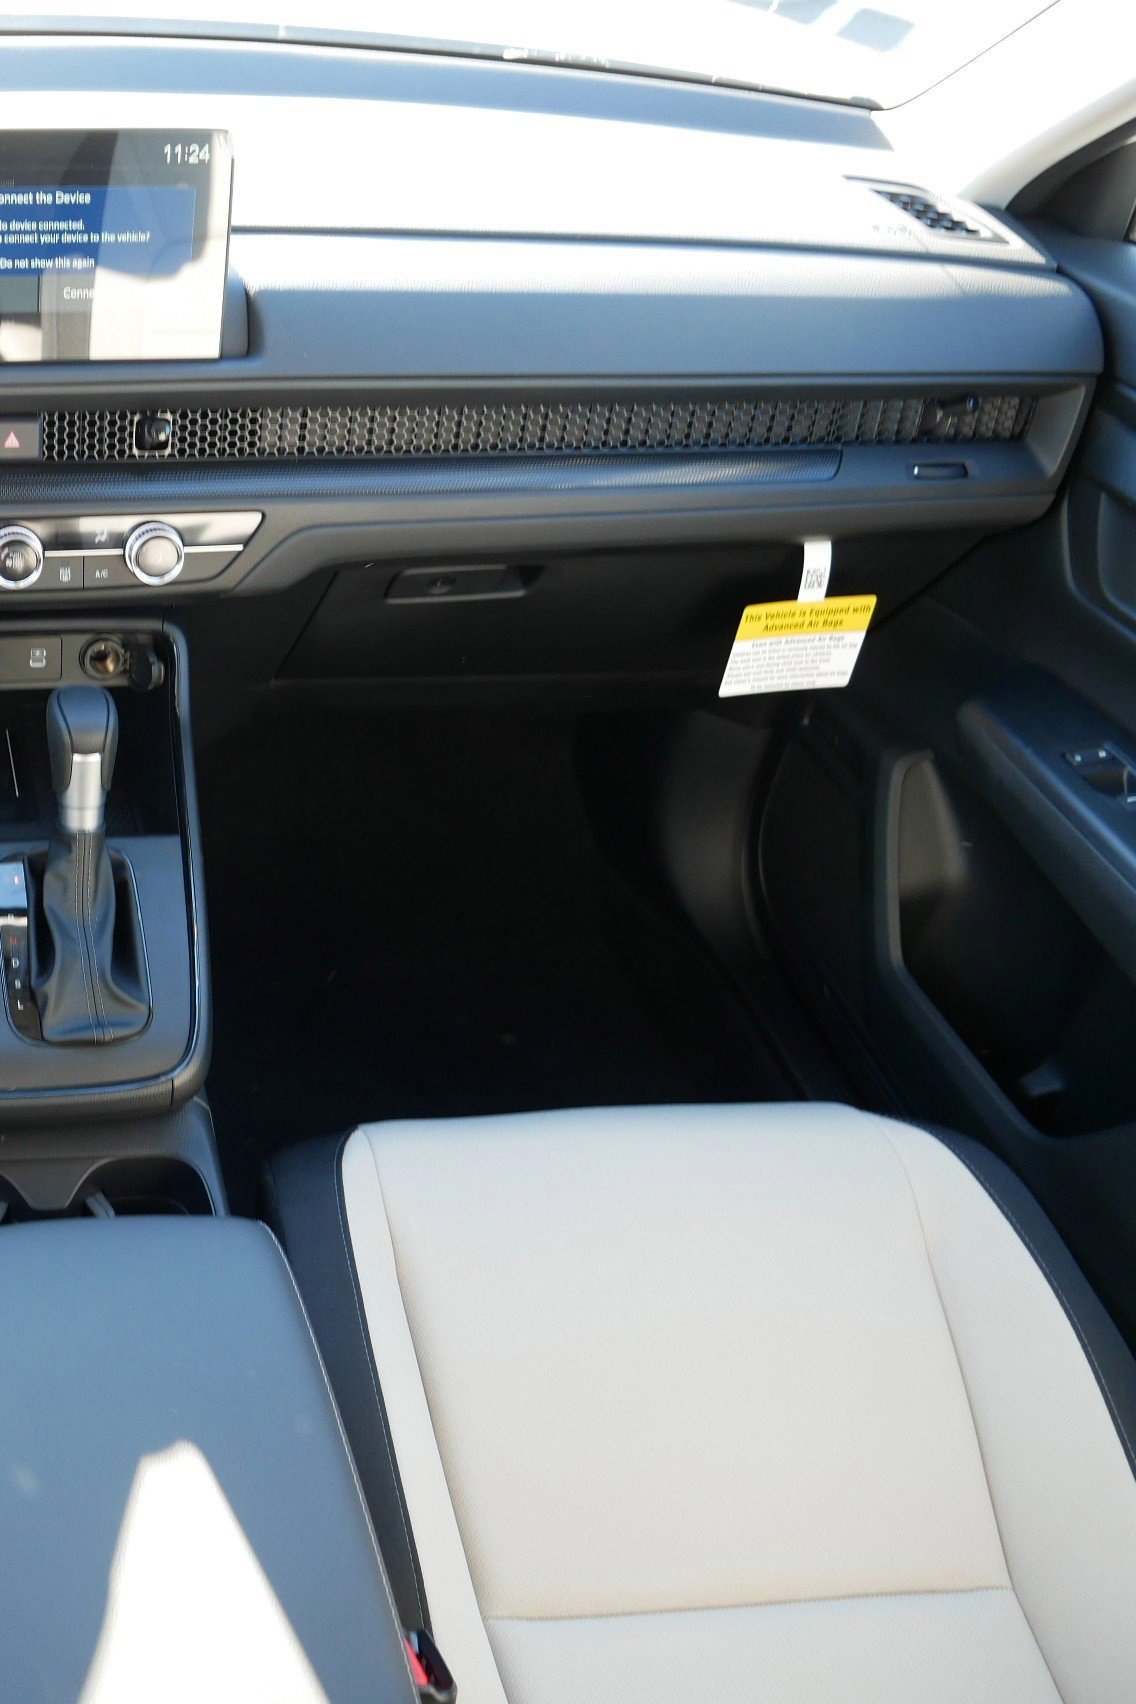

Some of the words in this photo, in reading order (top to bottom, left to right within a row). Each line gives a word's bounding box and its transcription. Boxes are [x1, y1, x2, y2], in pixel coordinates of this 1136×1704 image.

[163, 143, 211, 164] 11:24
[35, 190, 52, 205] the
[55, 190, 91, 205] Device
[9, 219, 37, 231] device
[38, 218, 85, 231] connected.
[4, 232, 37, 244] connect
[39, 233, 59, 245] your
[61, 231, 89, 244] device
[90, 231, 100, 243] to
[101, 231, 115, 243] the
[117, 230, 151, 243] vehicle?
[0, 257, 13, 270] Do
[14, 257, 29, 269] not
[30, 257, 54, 269] show
[54, 256, 71, 268] this
[72, 256, 95, 270] again
[63, 286, 95, 300] Conne
[95, 568, 109, 579] A/C
[744, 613, 762, 623] This
[765, 609, 796, 621] Vehicle
[799, 609, 807, 617] is
[809, 605, 851, 617] Equipped
[852, 605, 871, 614] with
[762, 619, 805, 633] Advanced
[806, 619, 820, 628] Air
[821, 619, 844, 628] Bags
[17, 998, 24, 1011] L
